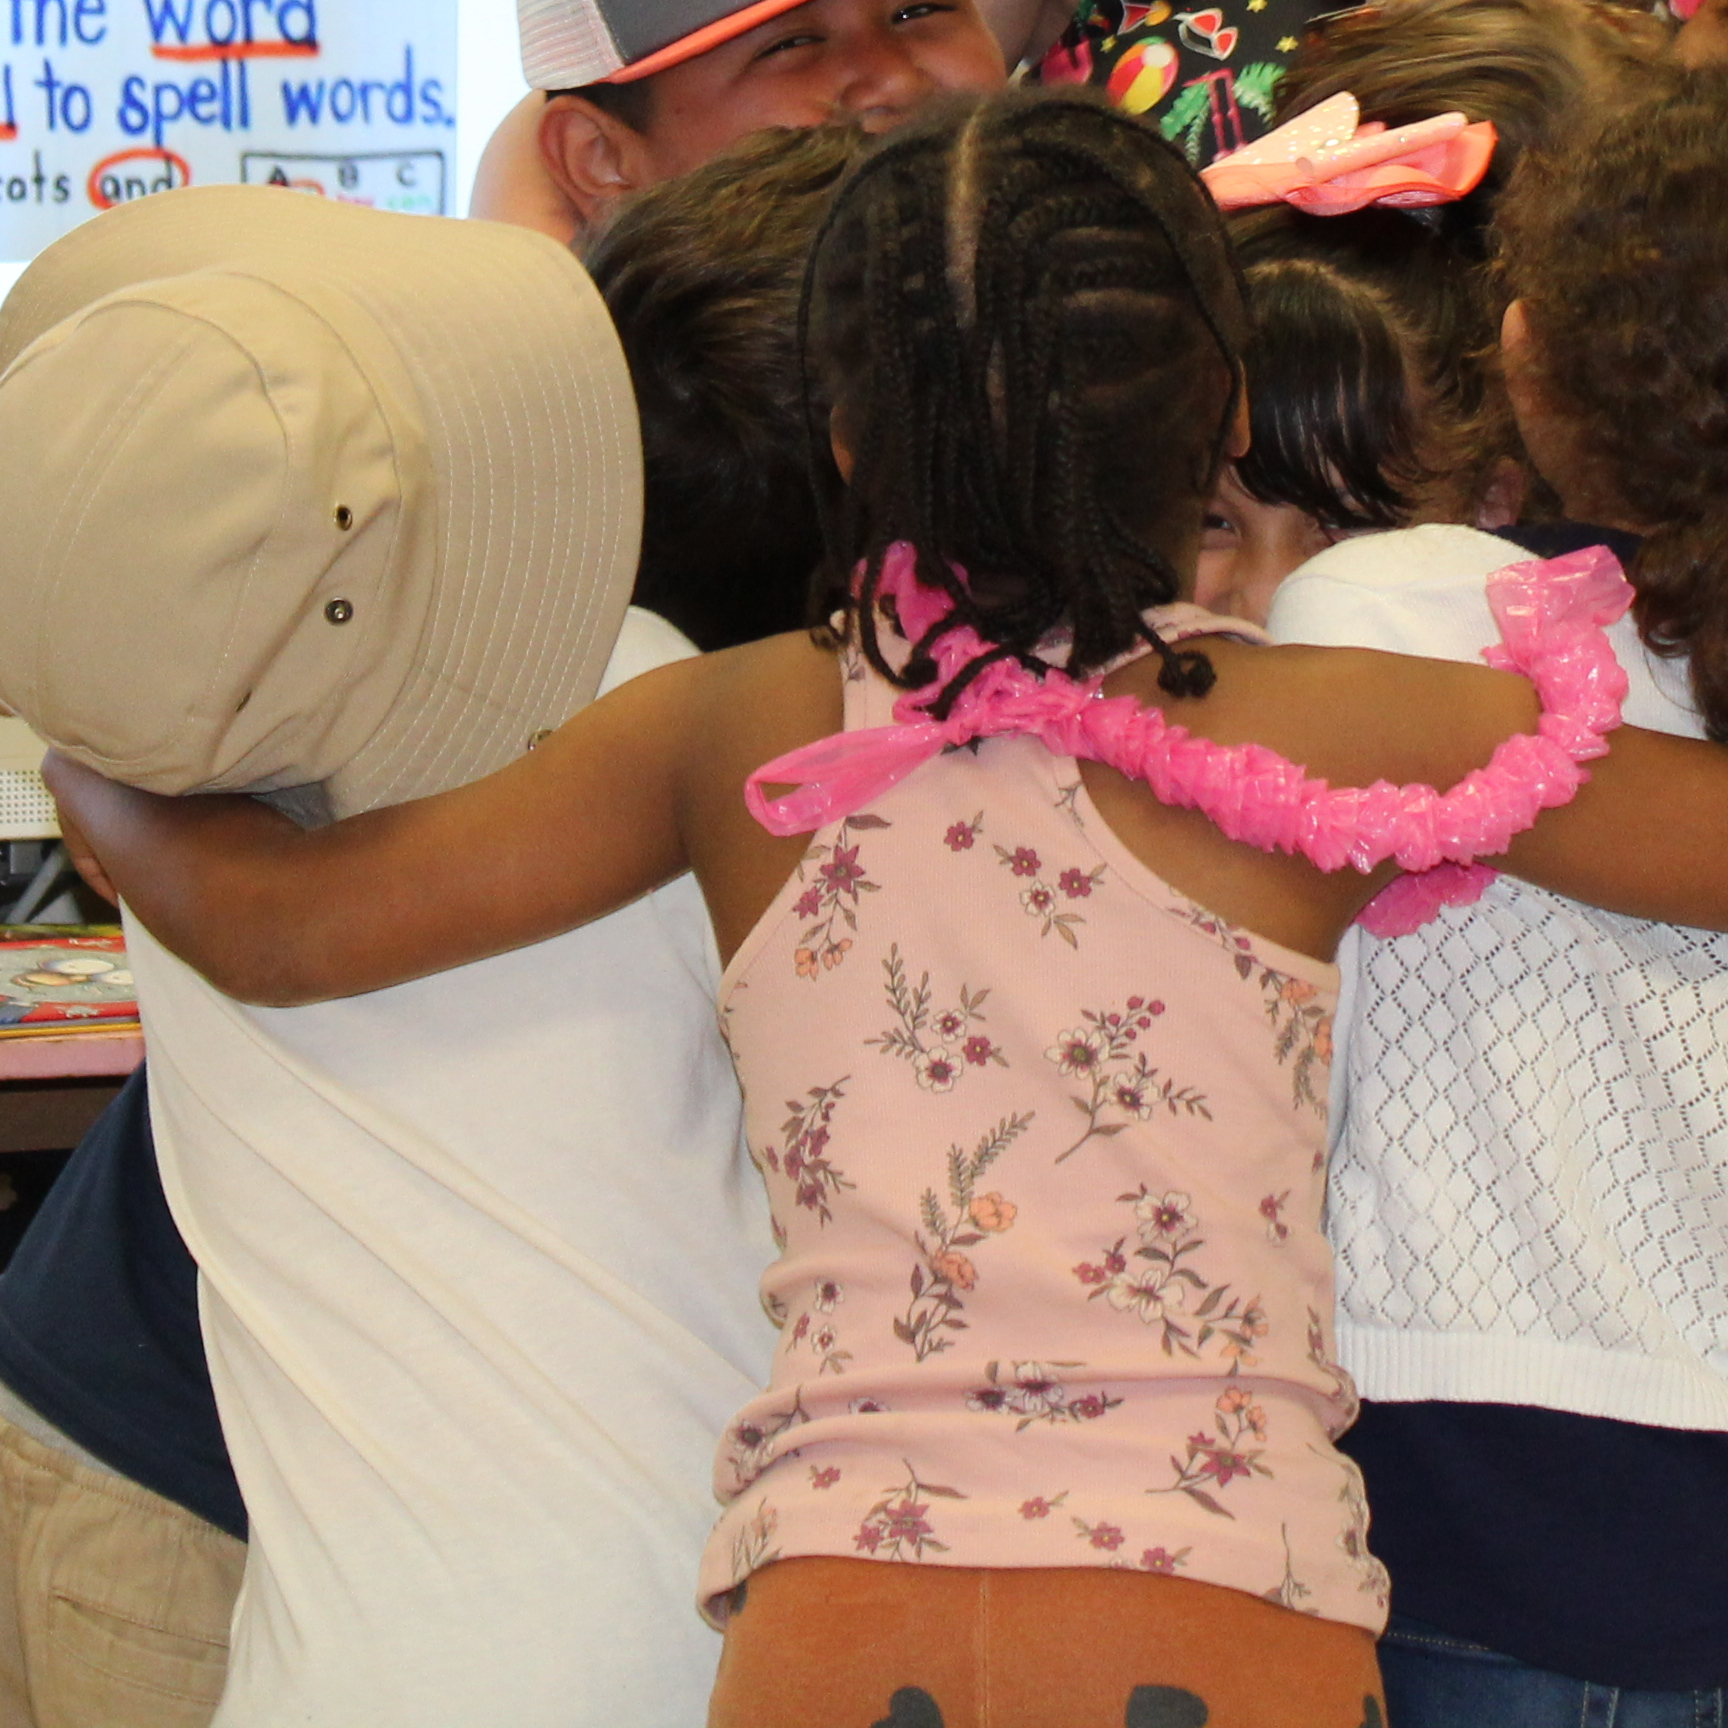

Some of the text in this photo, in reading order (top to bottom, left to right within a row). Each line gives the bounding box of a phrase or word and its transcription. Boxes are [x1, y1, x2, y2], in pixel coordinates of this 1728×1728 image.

[35, 58, 92, 132] to
[117, 57, 250, 149] spell
[283, 45, 457, 132] words.
[98, 152, 174, 200] and
